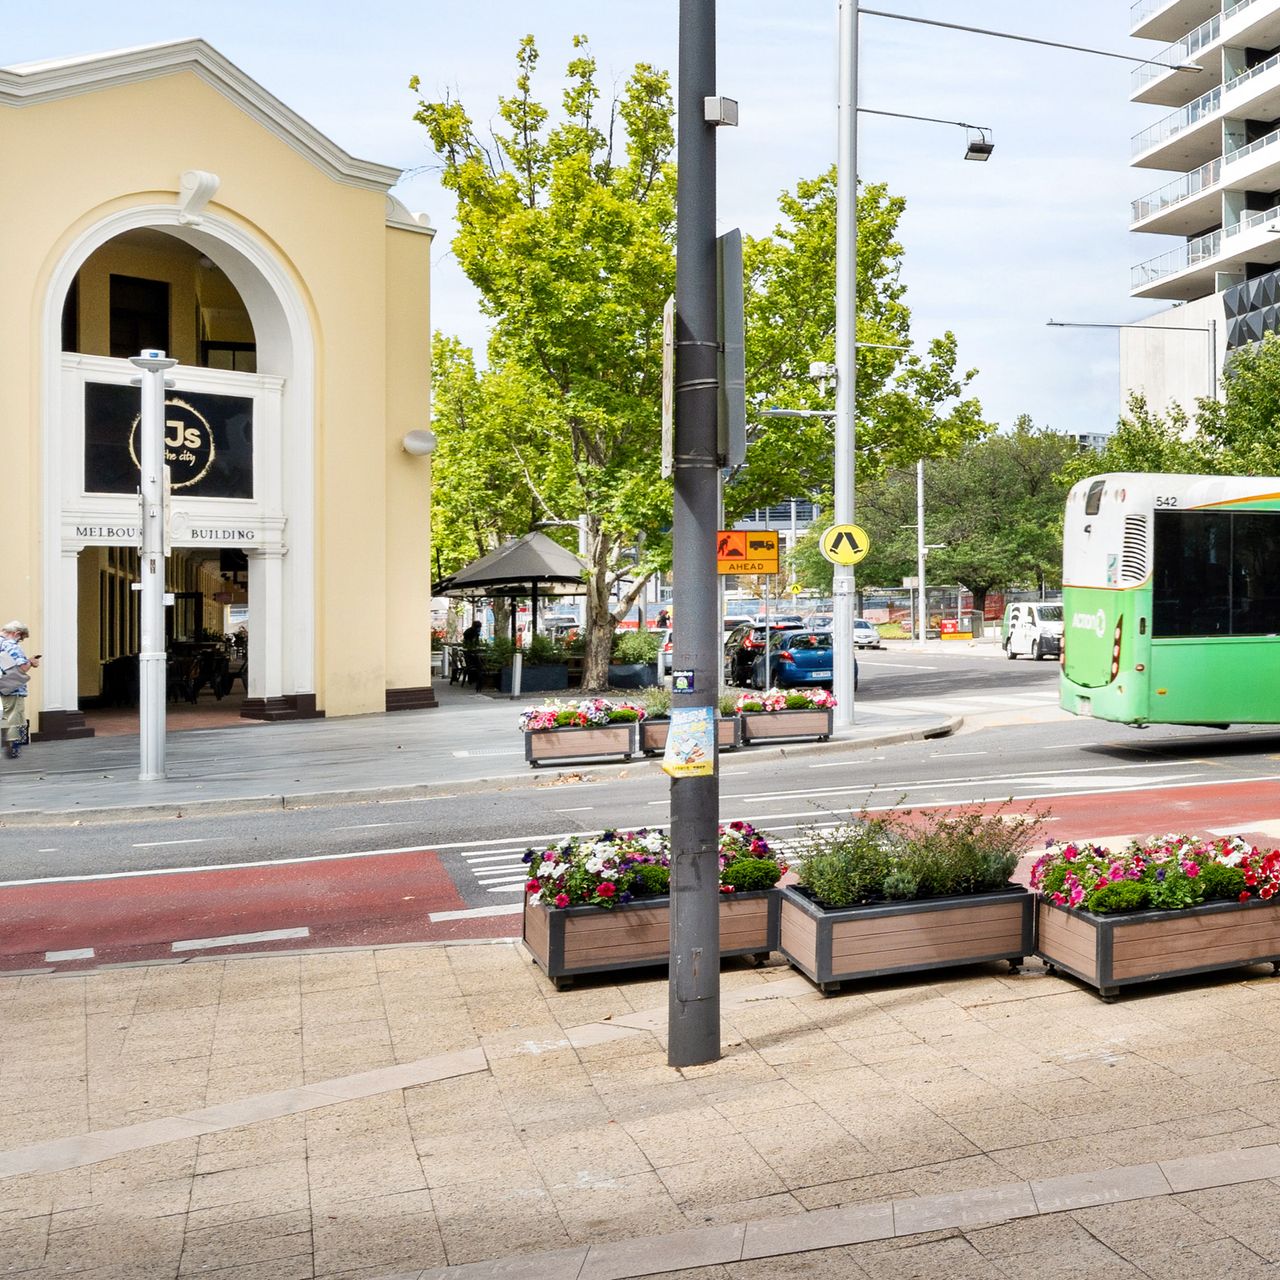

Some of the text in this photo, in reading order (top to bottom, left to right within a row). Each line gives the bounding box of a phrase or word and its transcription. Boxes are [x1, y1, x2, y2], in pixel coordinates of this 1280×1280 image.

[165, 420, 201, 448] Js
[165, 449, 196, 466] he city
[1156, 496, 1178, 507] 542
[191, 529, 255, 540] BUILDING
[728, 563, 764, 571] AHEAD
